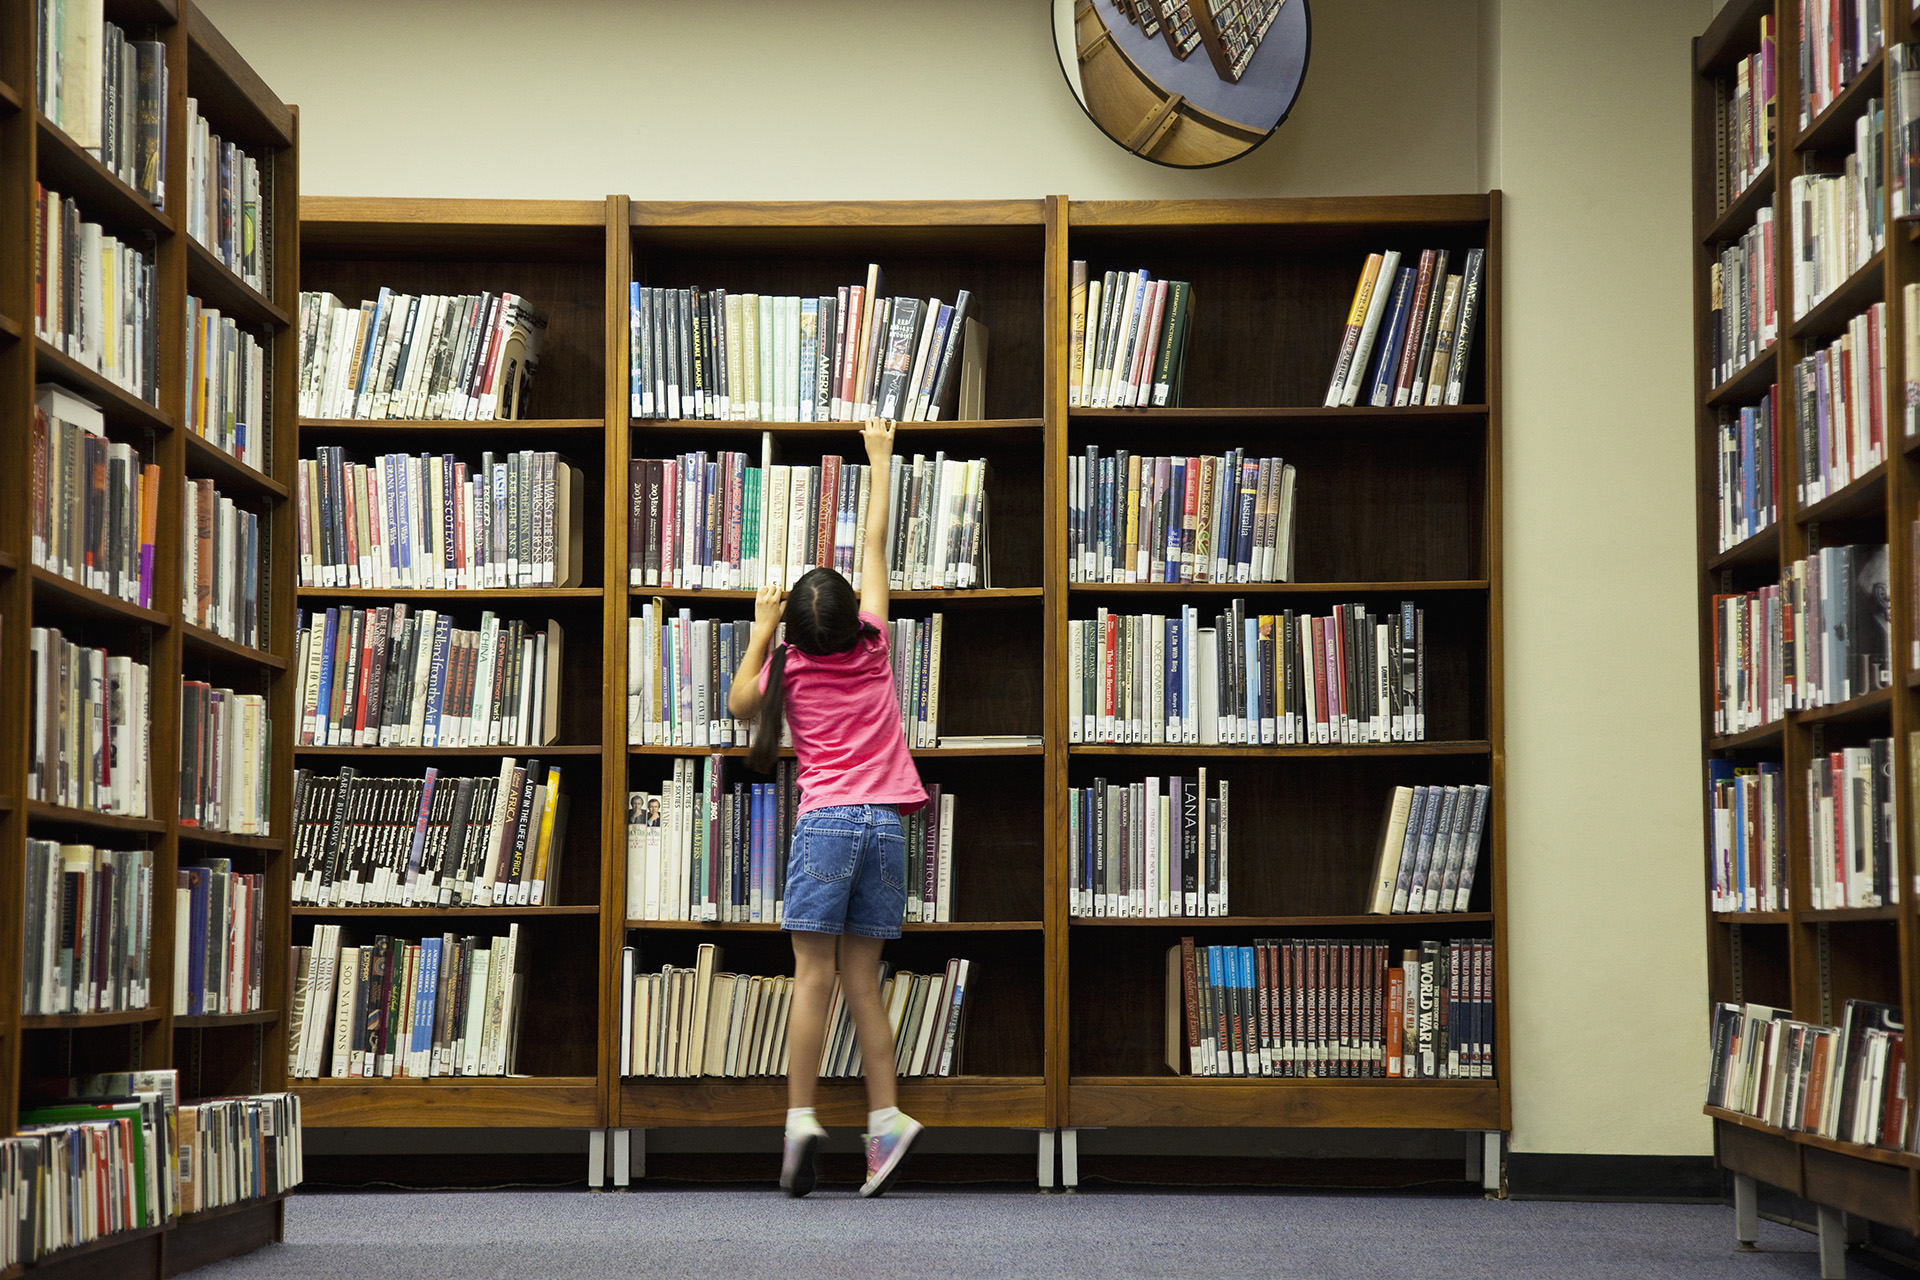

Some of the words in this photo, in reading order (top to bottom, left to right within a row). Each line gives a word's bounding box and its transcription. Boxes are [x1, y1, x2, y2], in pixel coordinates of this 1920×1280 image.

[1414, 262, 1434, 310] EGYPT
[1464, 282, 1478, 320] VALLEY
[1414, 311, 1424, 342] SPLENDORS
[1411, 352, 1417, 360] AN
[1455, 339, 1468, 371] KINGS
[819, 354, 830, 406] AMERICA
[496, 469, 505, 511] CASTLES
[533, 483, 542, 509] WARS
[733, 476, 742, 521] AMERICAN
[509, 495, 517, 529] GOTHIC
[533, 510, 542, 519] OF
[649, 495, 658, 517] YEARS
[1202, 505, 1210, 519] SUN
[1241, 493, 1252, 536] Australia
[400, 517, 407, 525] of
[445, 500, 454, 561] SCOTLAND
[474, 497, 483, 546] IRELAND
[533, 522, 542, 534] THE
[400, 526, 408, 545] Wales
[509, 530, 517, 554] KINGS
[731, 524, 741, 569] PRESIDENC
[533, 535, 542, 563] ROSES
[394, 605, 404, 634] SOVIETS
[424, 615, 432, 627] THE
[1171, 626, 1178, 634] My
[421, 630, 430, 658] VIKING
[432, 621, 448, 660] Holland
[480, 632, 490, 663] CHINA
[922, 622, 930, 674] remembering
[1154, 640, 1162, 663] NOEL
[321, 655, 329, 685] RUSSIA
[430, 663, 445, 687] from
[1154, 663, 1162, 702] COWARD
[428, 688, 440, 704] the
[426, 707, 436, 724] Air
[338, 772, 350, 800] LARRY
[426, 773, 435, 784] THE
[420, 787, 432, 816] VIETNAM
[524, 785, 533, 799] DAY
[675, 786, 683, 808] SIXTIES
[506, 789, 519, 823] AFRICA
[521, 809, 529, 823] THE
[663, 784, 671, 828] HEARTLANDS
[1185, 783, 1196, 828] LANA
[1407, 794, 1419, 833] RENAISSANCE
[329, 802, 344, 847] BURROWS
[417, 819, 426, 833] WAR
[518, 824, 527, 839] LIFE
[694, 819, 702, 832] BILL
[753, 819, 761, 833] THE
[517, 841, 525, 851] OF
[694, 833, 702, 859] MOYERS
[753, 836, 761, 849] WAY
[927, 825, 935, 860] WHITE
[512, 851, 523, 876] AFRICA
[753, 853, 761, 865] WE
[753, 867, 761, 889] WERE
[925, 862, 935, 899] HOUSE
[308, 957, 318, 991] INDIANS
[1186, 957, 1194, 968] The
[343, 965, 352, 986] 500
[1187, 971, 1195, 996] Golden
[1420, 961, 1433, 1009] WORLD
[1407, 998, 1415, 1015] GREAT
[338, 990, 351, 1050] NATIONS
[1406, 1017, 1414, 1029] WAR
[1419, 1012, 1432, 1041] WAR
[1433, 1022, 1440, 1030] OF
[1190, 1021, 1198, 1045] Europe
[1419, 1043, 1432, 1052] II
